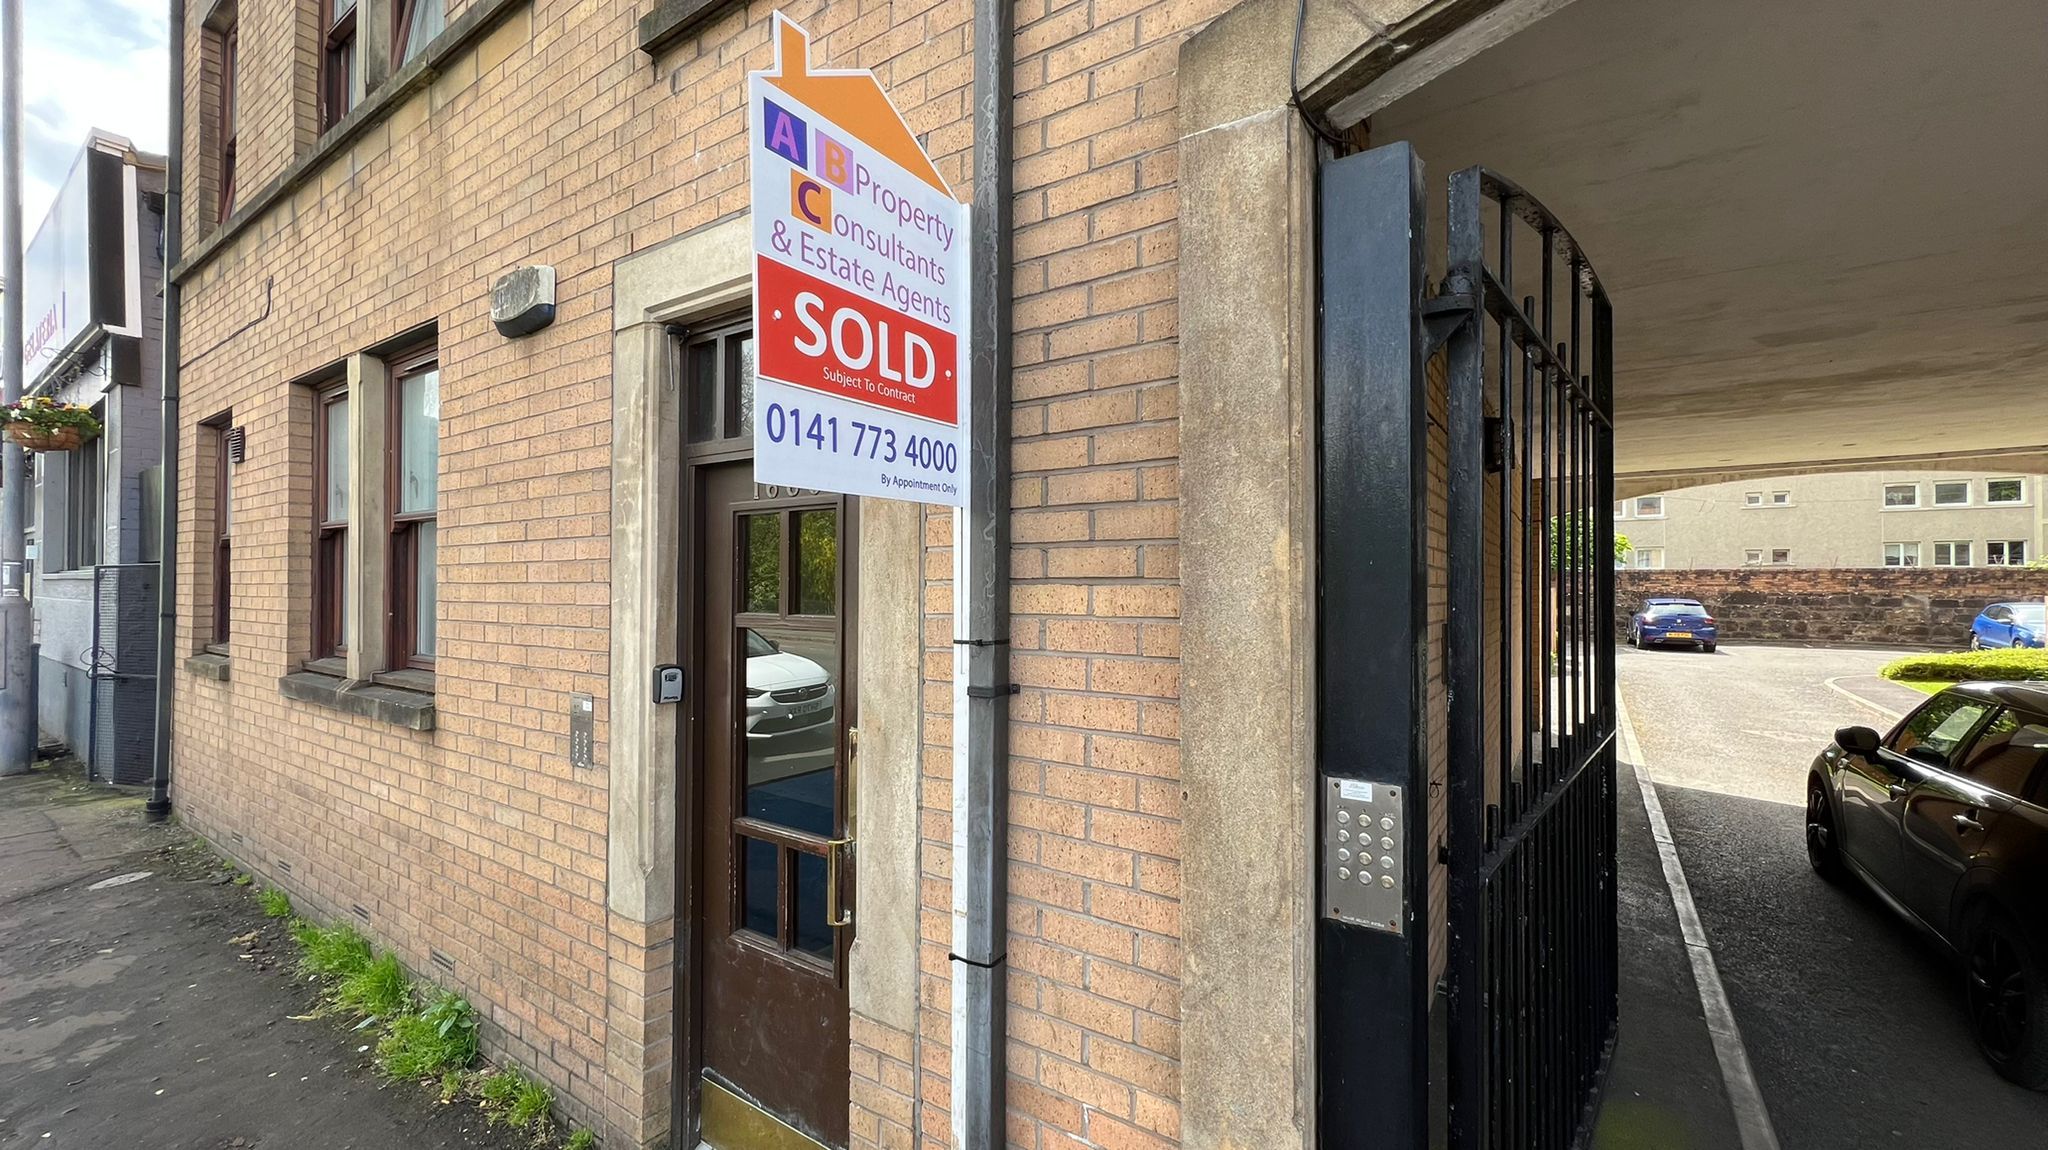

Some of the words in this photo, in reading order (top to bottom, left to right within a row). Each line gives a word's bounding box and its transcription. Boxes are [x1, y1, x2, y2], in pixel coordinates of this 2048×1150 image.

[856, 163, 954, 251] Property
[771, 219, 792, 256] &
[801, 232, 875, 292] Estate
[882, 271, 951, 324] Agents
[794, 291, 936, 389] SOLD
[823, 367, 862, 389] Subject
[864, 378, 876, 392] To
[878, 382, 916, 404] Contract
[767, 403, 838, 453] 0141
[852, 421, 897, 463] 773
[905, 434, 957, 474] 4000
[881, 473, 892, 487] By
[893, 475, 941, 492] Appointment
[942, 483, 958, 496] Only
